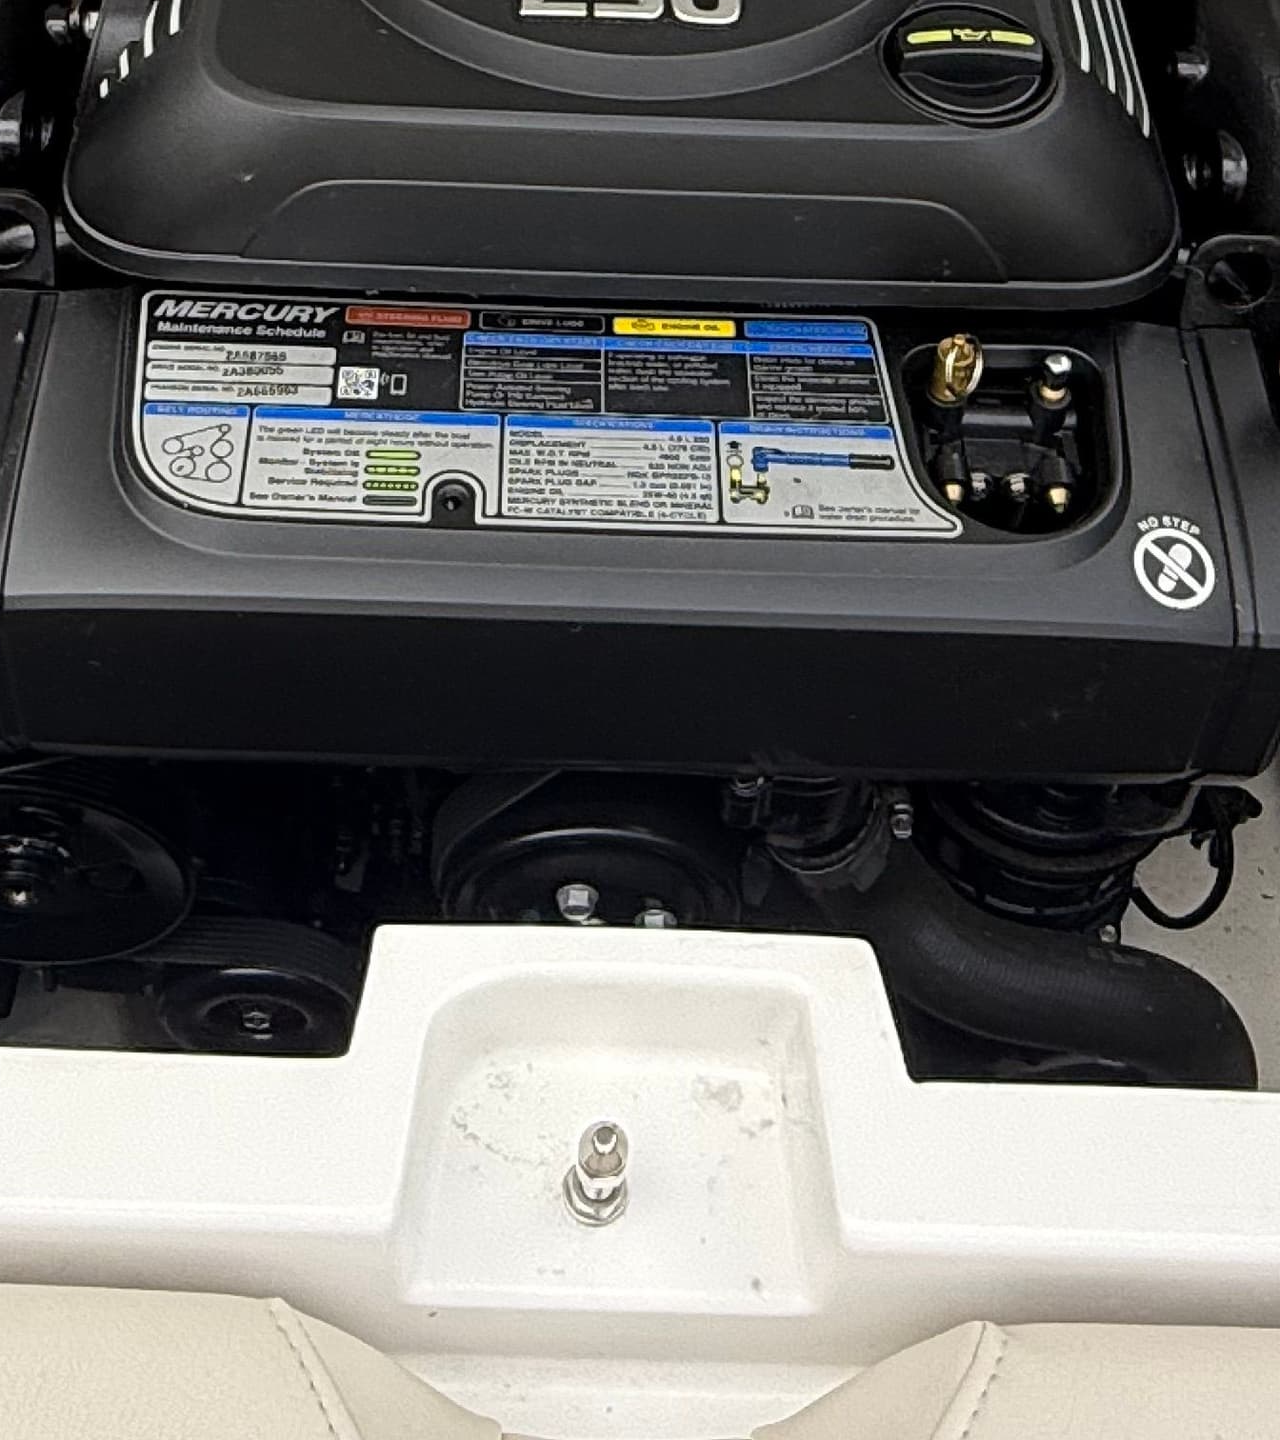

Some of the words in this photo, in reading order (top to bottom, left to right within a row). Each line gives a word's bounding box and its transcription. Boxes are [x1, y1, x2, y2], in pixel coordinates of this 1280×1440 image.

[153, 299, 341, 324] MERCURY
[157, 320, 253, 337] Maintenance
[255, 325, 327, 340] Schedule
[267, 476, 308, 486] Service
[249, 492, 269, 501] See
[317, 494, 357, 503] Manual
[507, 497, 557, 506] MERCURY
[1136, 515, 1159, 533] NO
[1161, 514, 1201, 536] STEP
